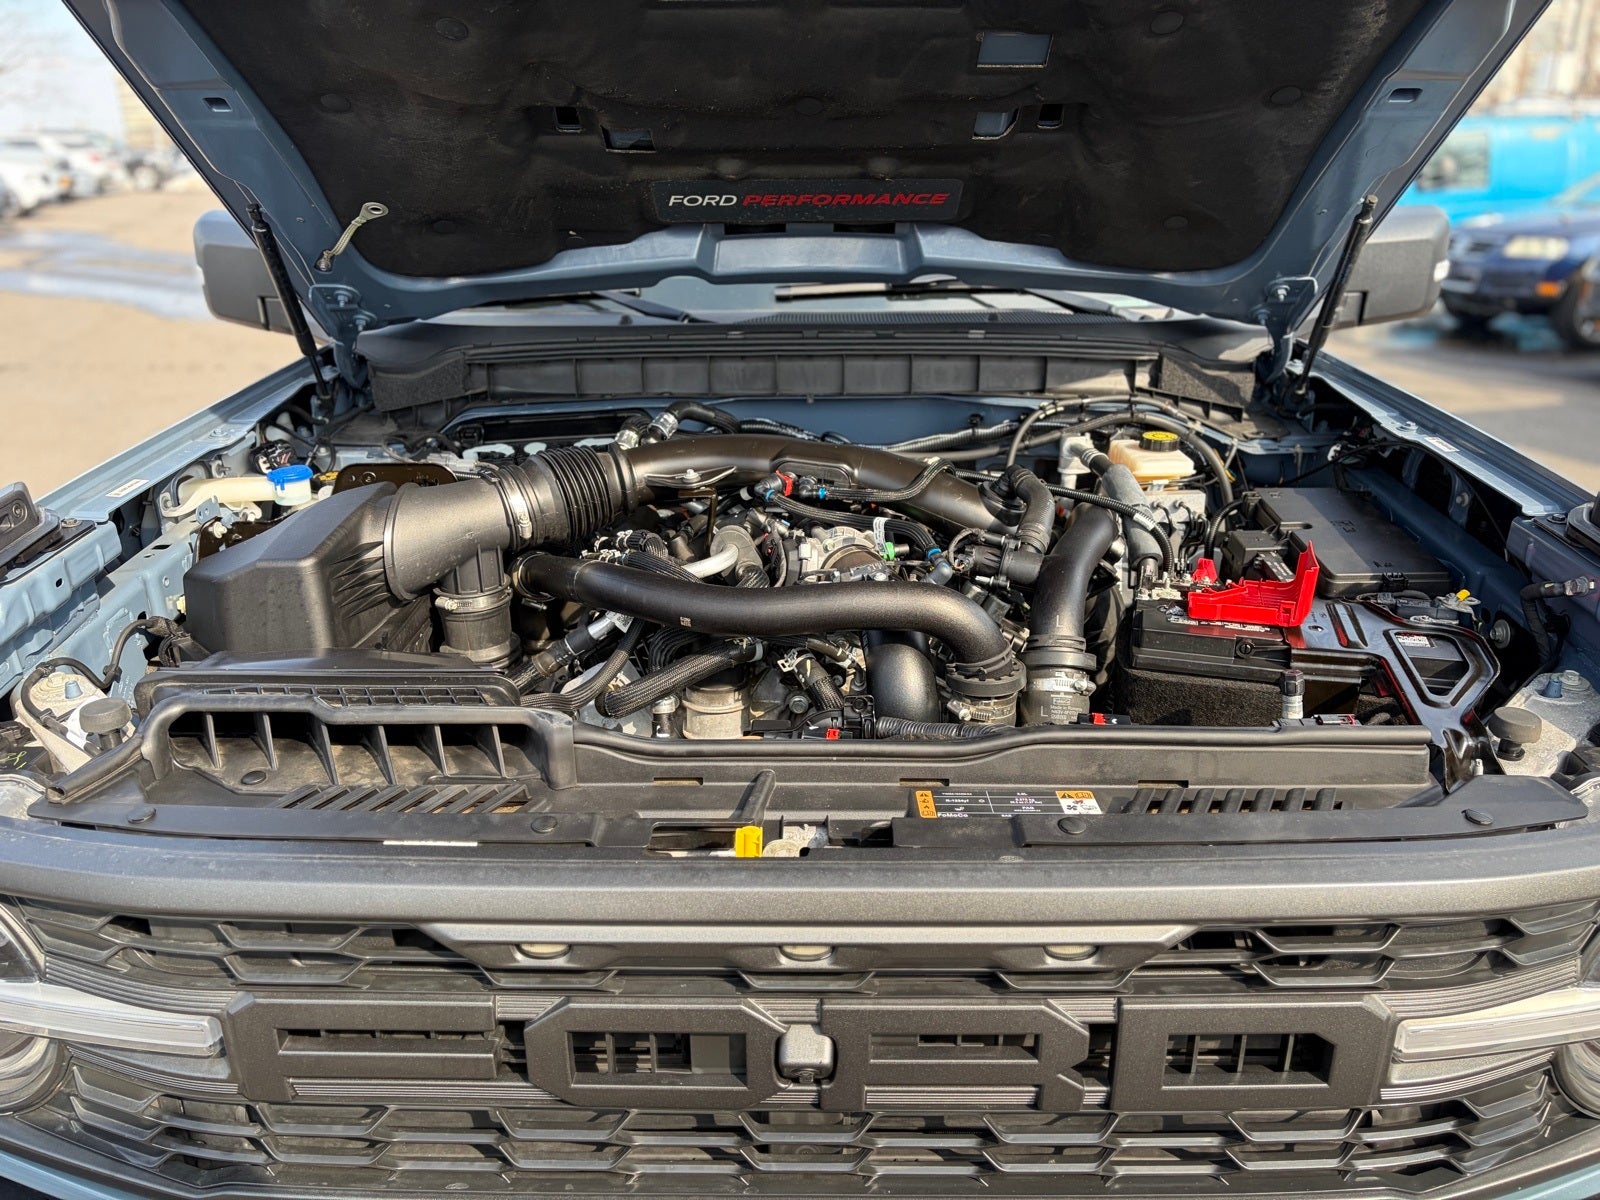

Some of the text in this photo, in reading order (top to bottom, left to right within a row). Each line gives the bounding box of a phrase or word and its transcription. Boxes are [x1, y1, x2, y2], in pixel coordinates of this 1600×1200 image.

[668, 193, 950, 207] FORD PERFORMANCE
[226, 996, 1392, 1110] FORD
